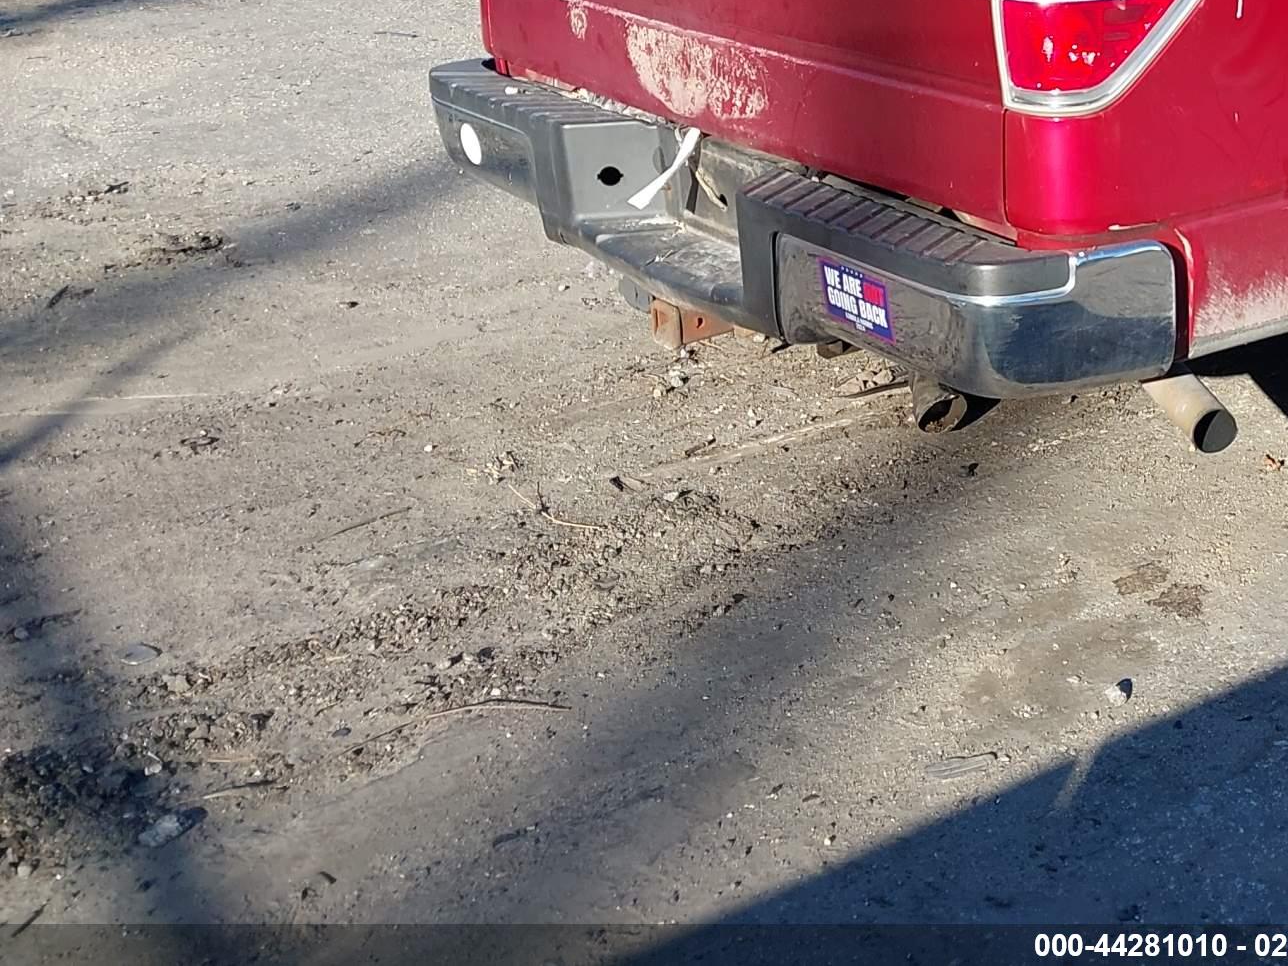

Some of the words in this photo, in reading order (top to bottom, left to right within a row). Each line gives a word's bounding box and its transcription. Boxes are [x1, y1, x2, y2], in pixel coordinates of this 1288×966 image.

[823, 265, 842, 289] WE
[842, 273, 863, 299] ARE
[827, 285, 858, 315] GOING
[858, 299, 888, 328] BACK
